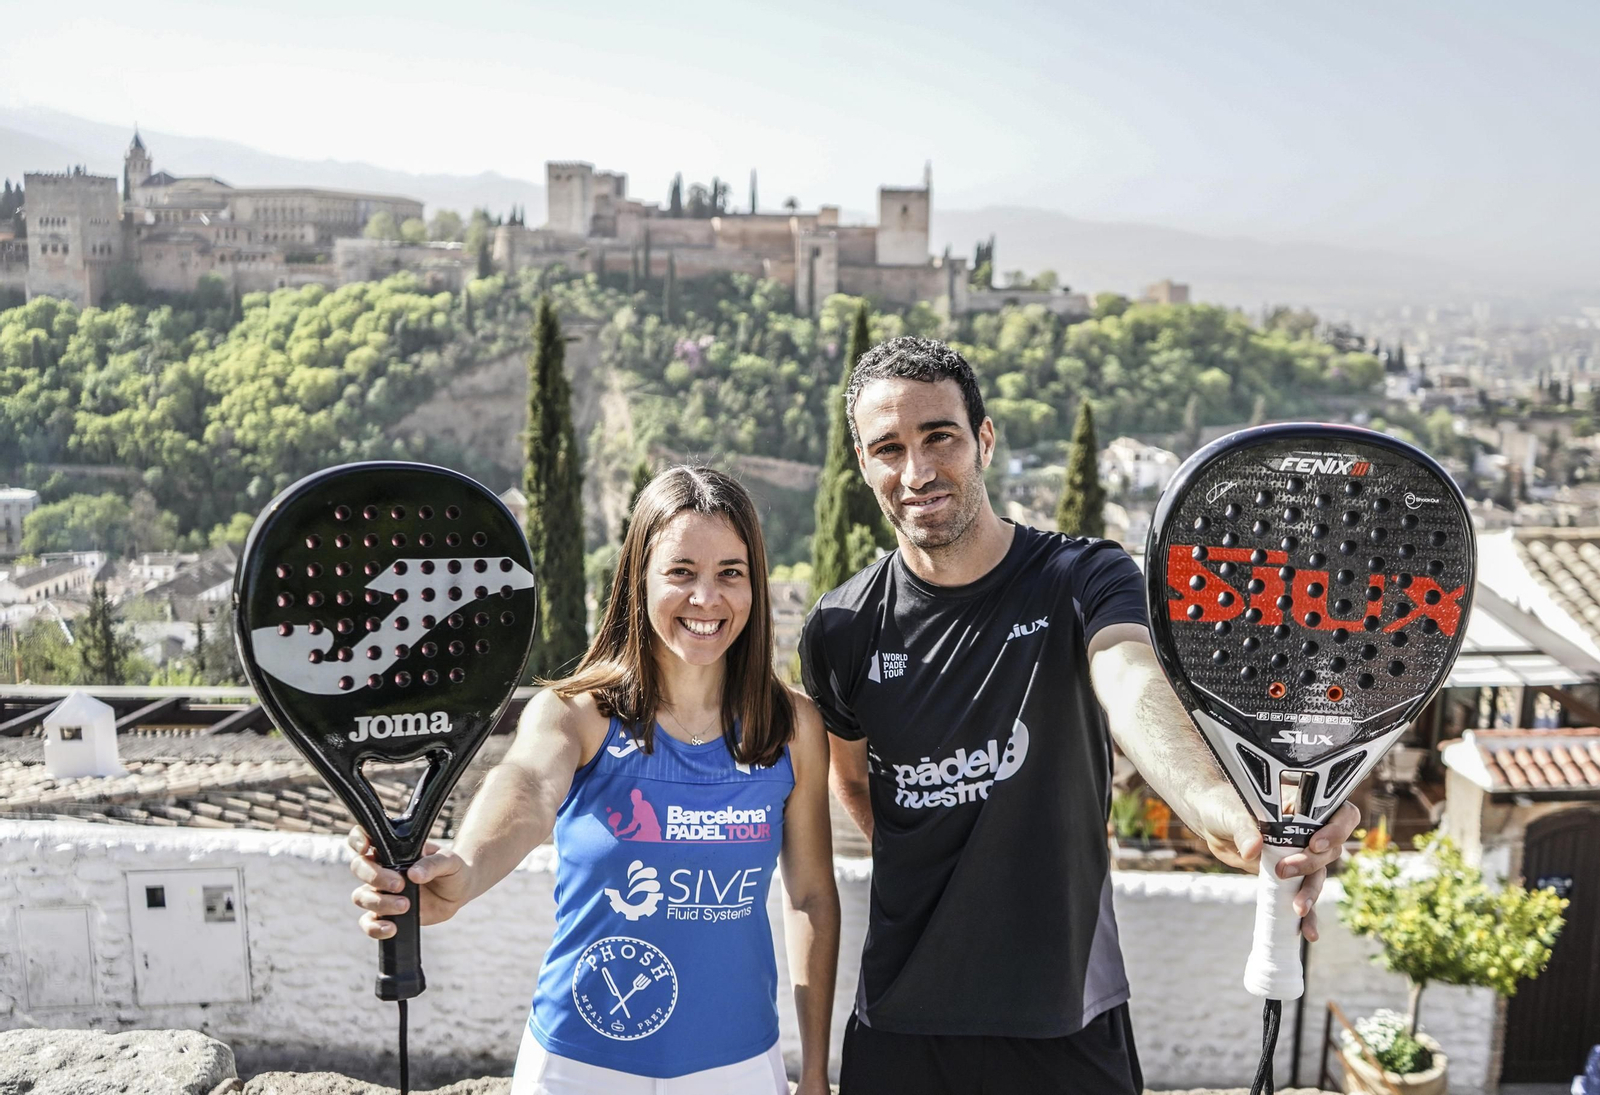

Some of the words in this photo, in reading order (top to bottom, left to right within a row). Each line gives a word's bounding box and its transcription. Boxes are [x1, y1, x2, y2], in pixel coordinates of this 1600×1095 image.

[1279, 457, 1353, 475] FENIX
[882, 653, 908, 661] WORLD
[883, 661, 907, 670] PADEL
[883, 669, 904, 679] TOUR
[1271, 730, 1334, 746] SIUX
[668, 867, 762, 904] SIVE
[667, 908, 699, 920] Fluid
[702, 907, 752, 923] Systems
[585, 944, 670, 981] PHOSH
[581, 994, 603, 1024] MEAL
[637, 1007, 663, 1030] PREP
